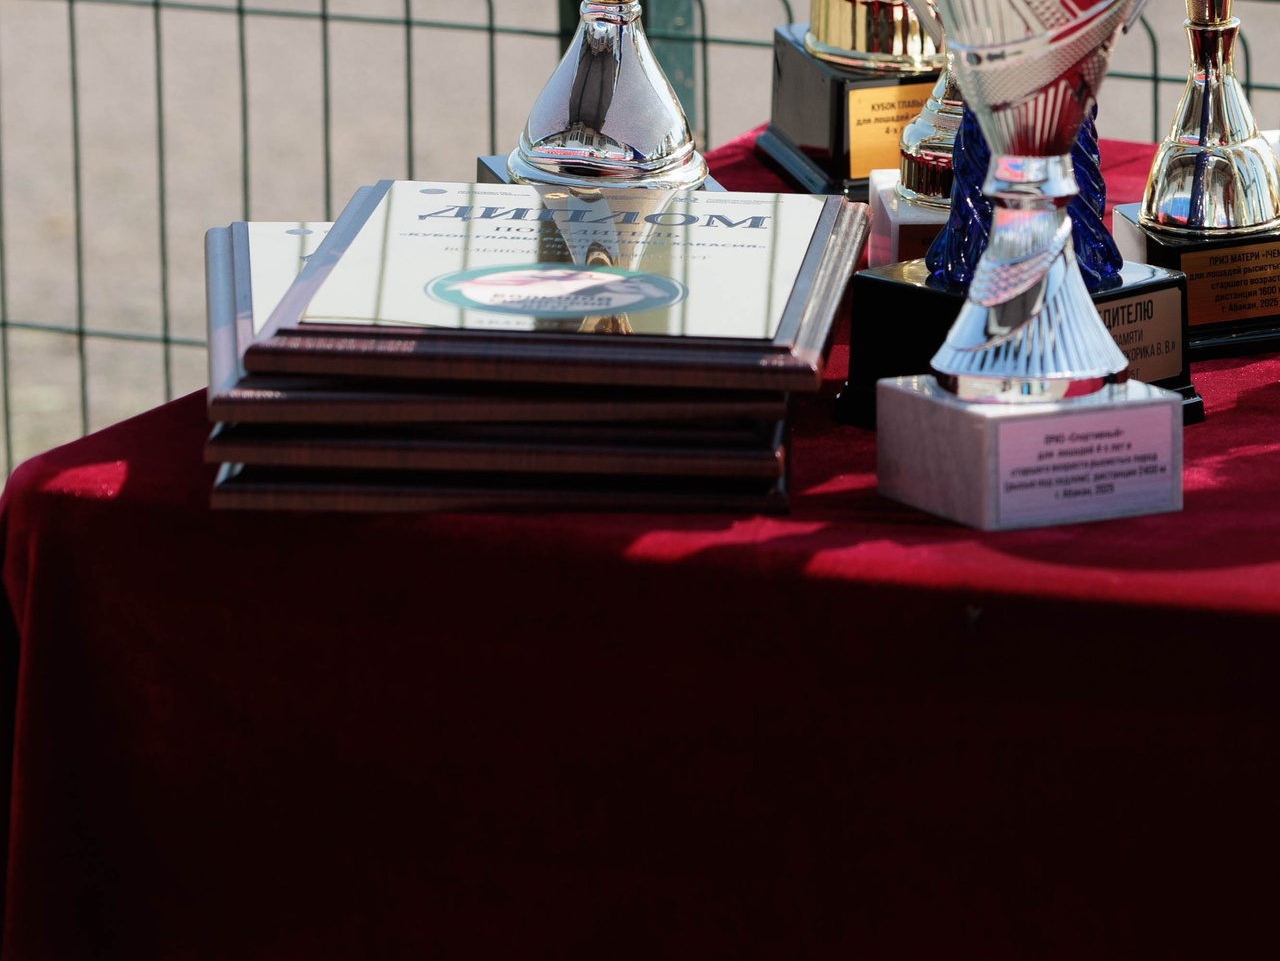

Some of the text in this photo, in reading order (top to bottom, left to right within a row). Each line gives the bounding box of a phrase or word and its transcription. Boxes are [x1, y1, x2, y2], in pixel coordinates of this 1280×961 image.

[871, 102, 896, 111] КУБОК
[418, 205, 772, 229] ДИПЛОМ
[1209, 254, 1229, 266] ПРИЗ
[1230, 251, 1260, 263] МАТЕРИ
[1188, 272, 1205, 282] для
[1206, 266, 1242, 278] лошадей
[1211, 278, 1248, 290] старшего
[1214, 291, 1258, 303] дистанция
[1259, 285, 1277, 296] 1600
[1260, 297, 1279, 308] 2025
[1098, 299, 1154, 330] ДИТЕЛЮ
